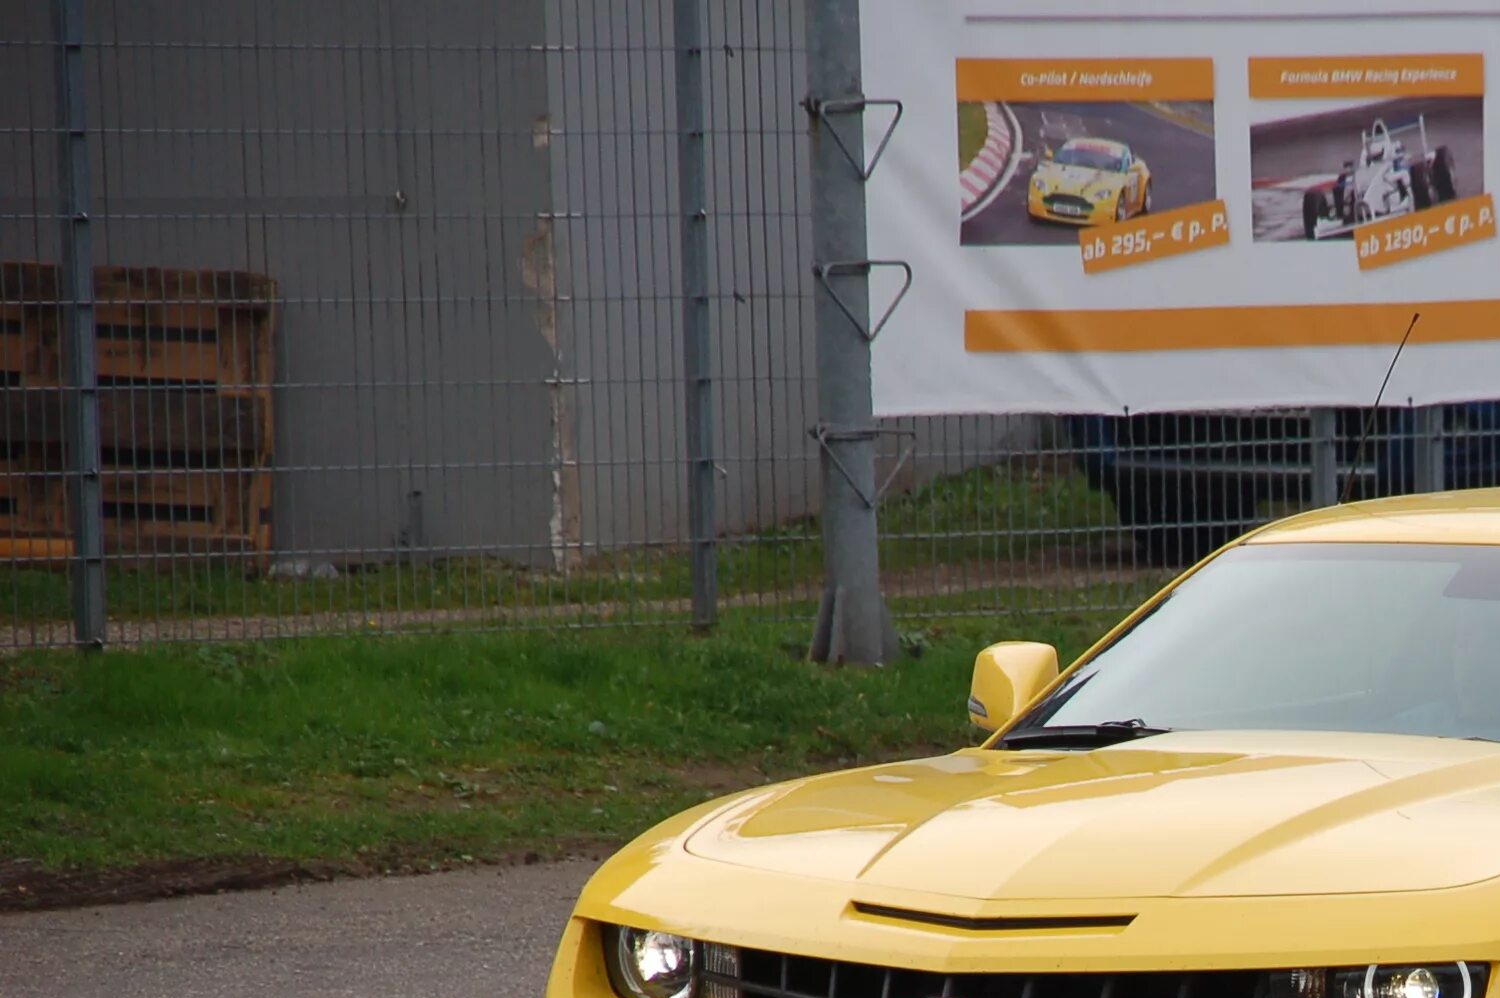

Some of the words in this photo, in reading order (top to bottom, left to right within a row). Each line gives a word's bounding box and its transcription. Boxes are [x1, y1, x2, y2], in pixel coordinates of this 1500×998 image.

[1020, 71, 1067, 86] Co-Pilot
[1079, 70, 1153, 88] Nordschleife
[1331, 70, 1363, 83] BMW
[1365, 70, 1400, 84] Racing
[1401, 67, 1457, 83] Experience
[1083, 237, 1106, 261] ab
[1171, 220, 1184, 241] €
[1189, 220, 1206, 244] p.
[1360, 234, 1379, 258] ab
